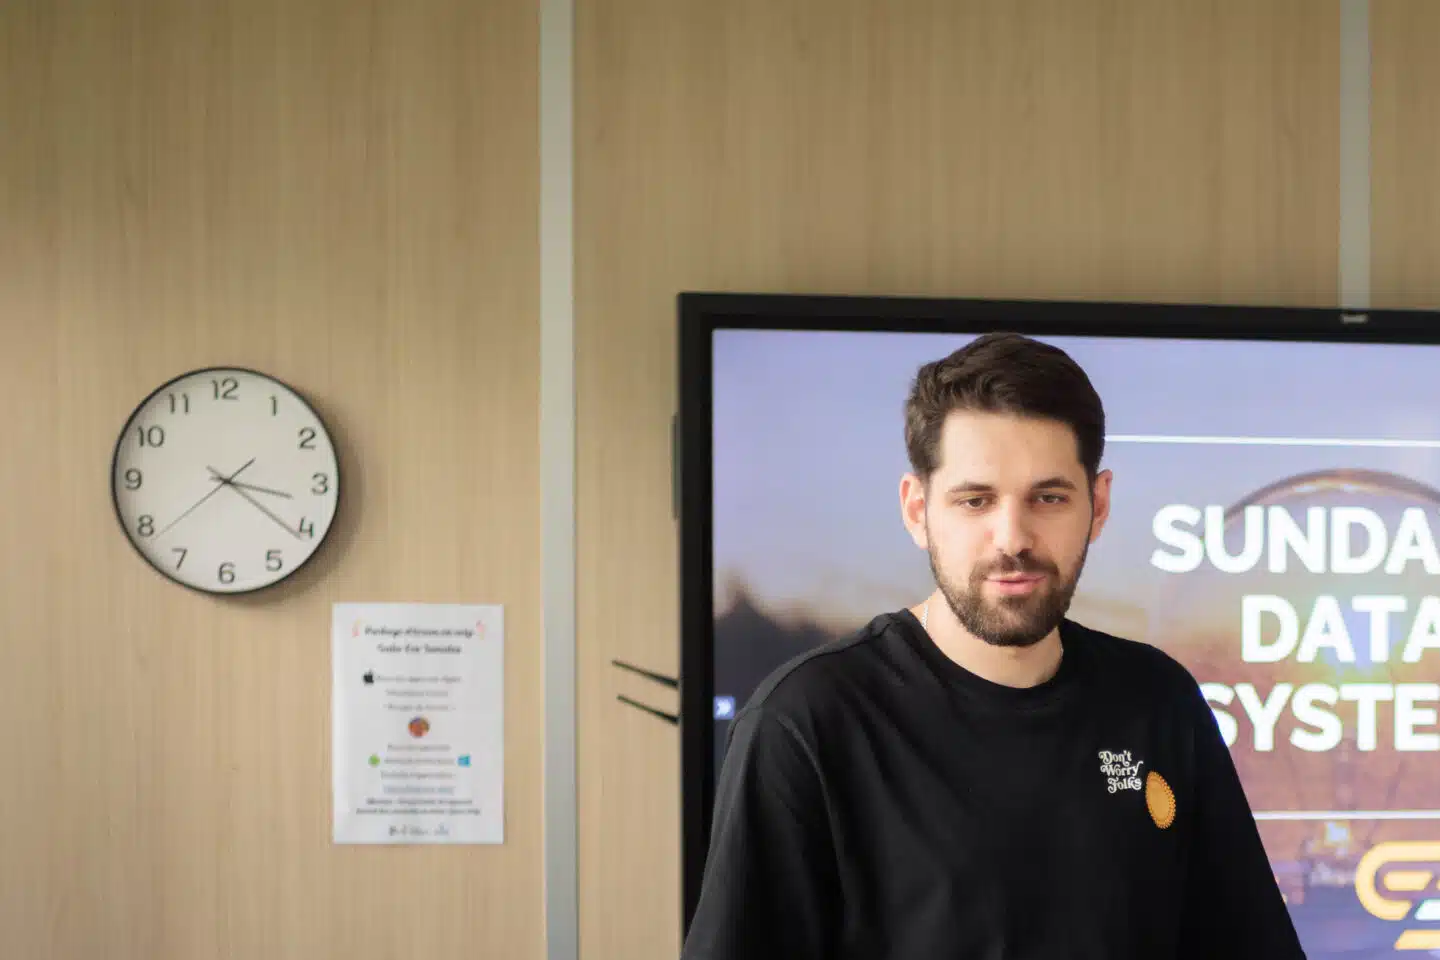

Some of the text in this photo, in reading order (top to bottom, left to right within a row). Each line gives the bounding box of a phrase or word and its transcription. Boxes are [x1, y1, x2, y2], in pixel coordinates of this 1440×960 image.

[212, 377, 239, 400] 12
[168, 393, 189, 414] 11
[269, 395, 278, 416] 1
[137, 425, 164, 448] 10
[298, 427, 316, 450] 2
[125, 468, 142, 490] 9
[311, 473, 329, 496] 3
[137, 514, 154, 537] 8
[299, 517, 314, 538] 4
[172, 548, 188, 571] 7
[265, 550, 282, 572] 5
[218, 562, 236, 584] 6
[1098, 750, 1132, 767] Don't
[1100, 760, 1144, 777] Worry
[1107, 776, 1142, 793] Folks
